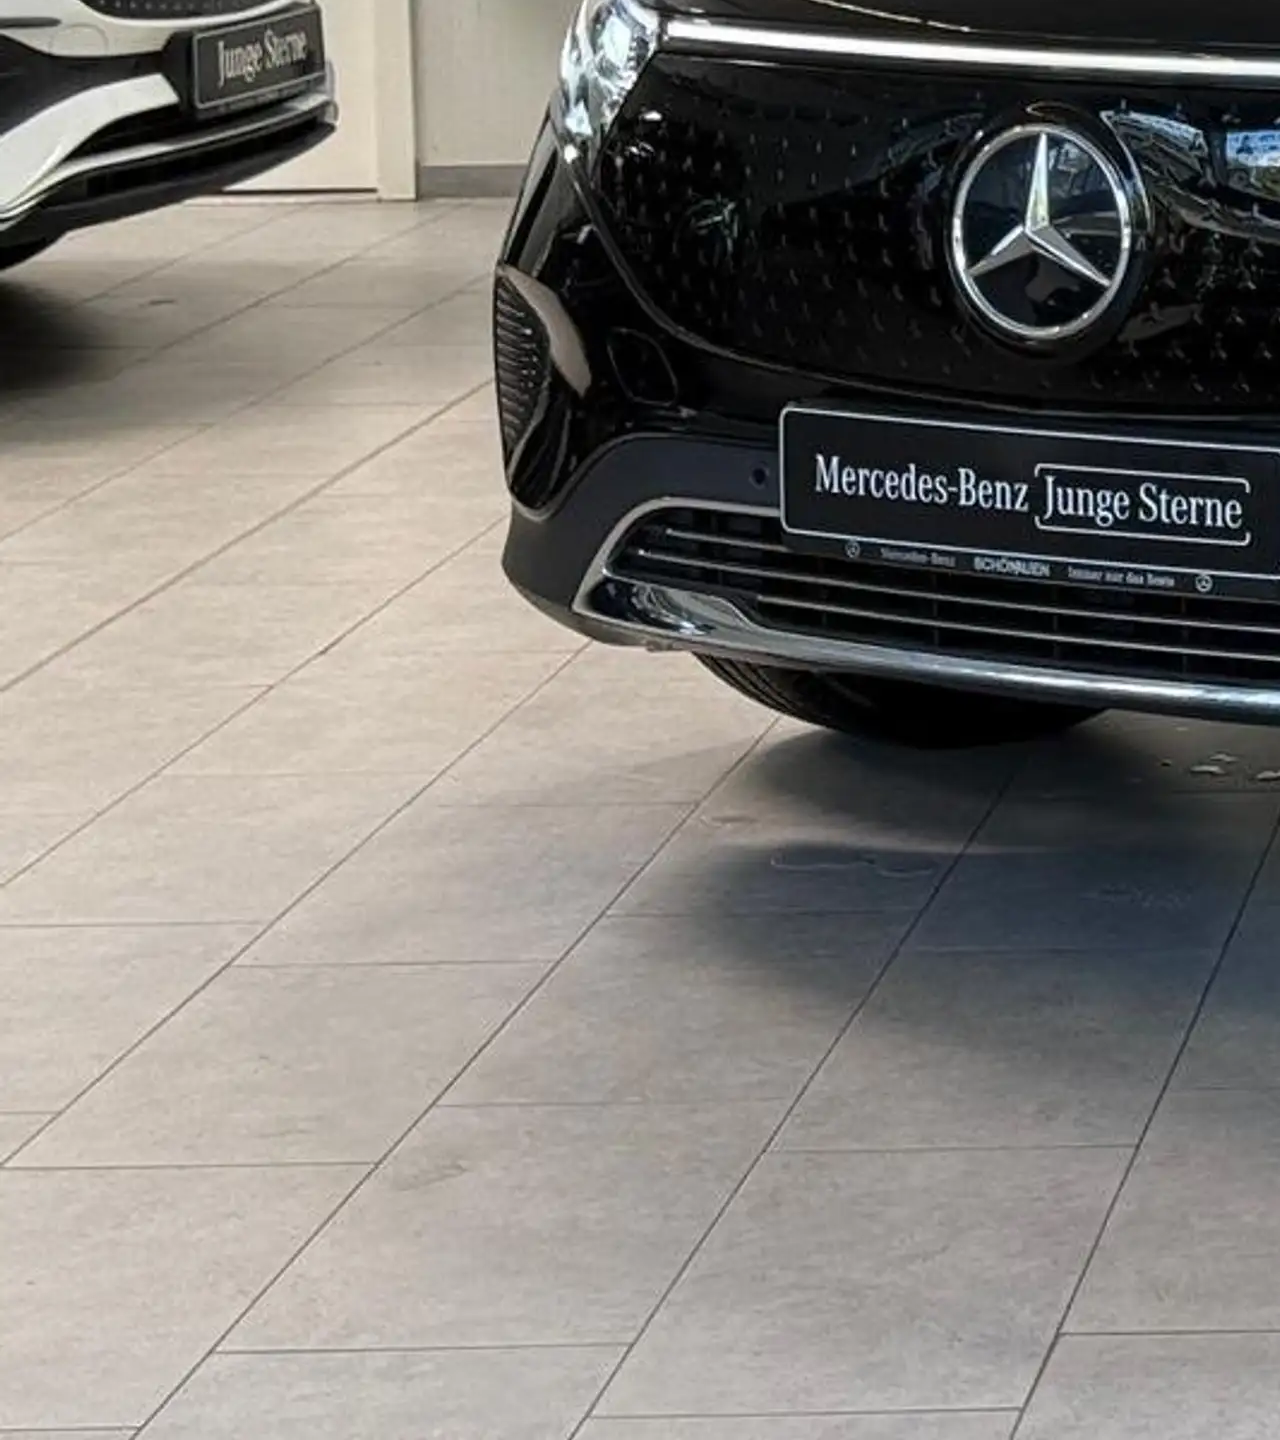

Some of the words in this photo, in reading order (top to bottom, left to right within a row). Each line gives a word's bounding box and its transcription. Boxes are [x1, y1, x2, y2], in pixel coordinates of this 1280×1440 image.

[218, 41, 262, 89] Junge
[264, 28, 307, 68] Sterne
[815, 453, 1028, 512] Mercedes-Benz
[1045, 474, 1130, 526] Junge
[1139, 482, 1243, 529] Sterne
